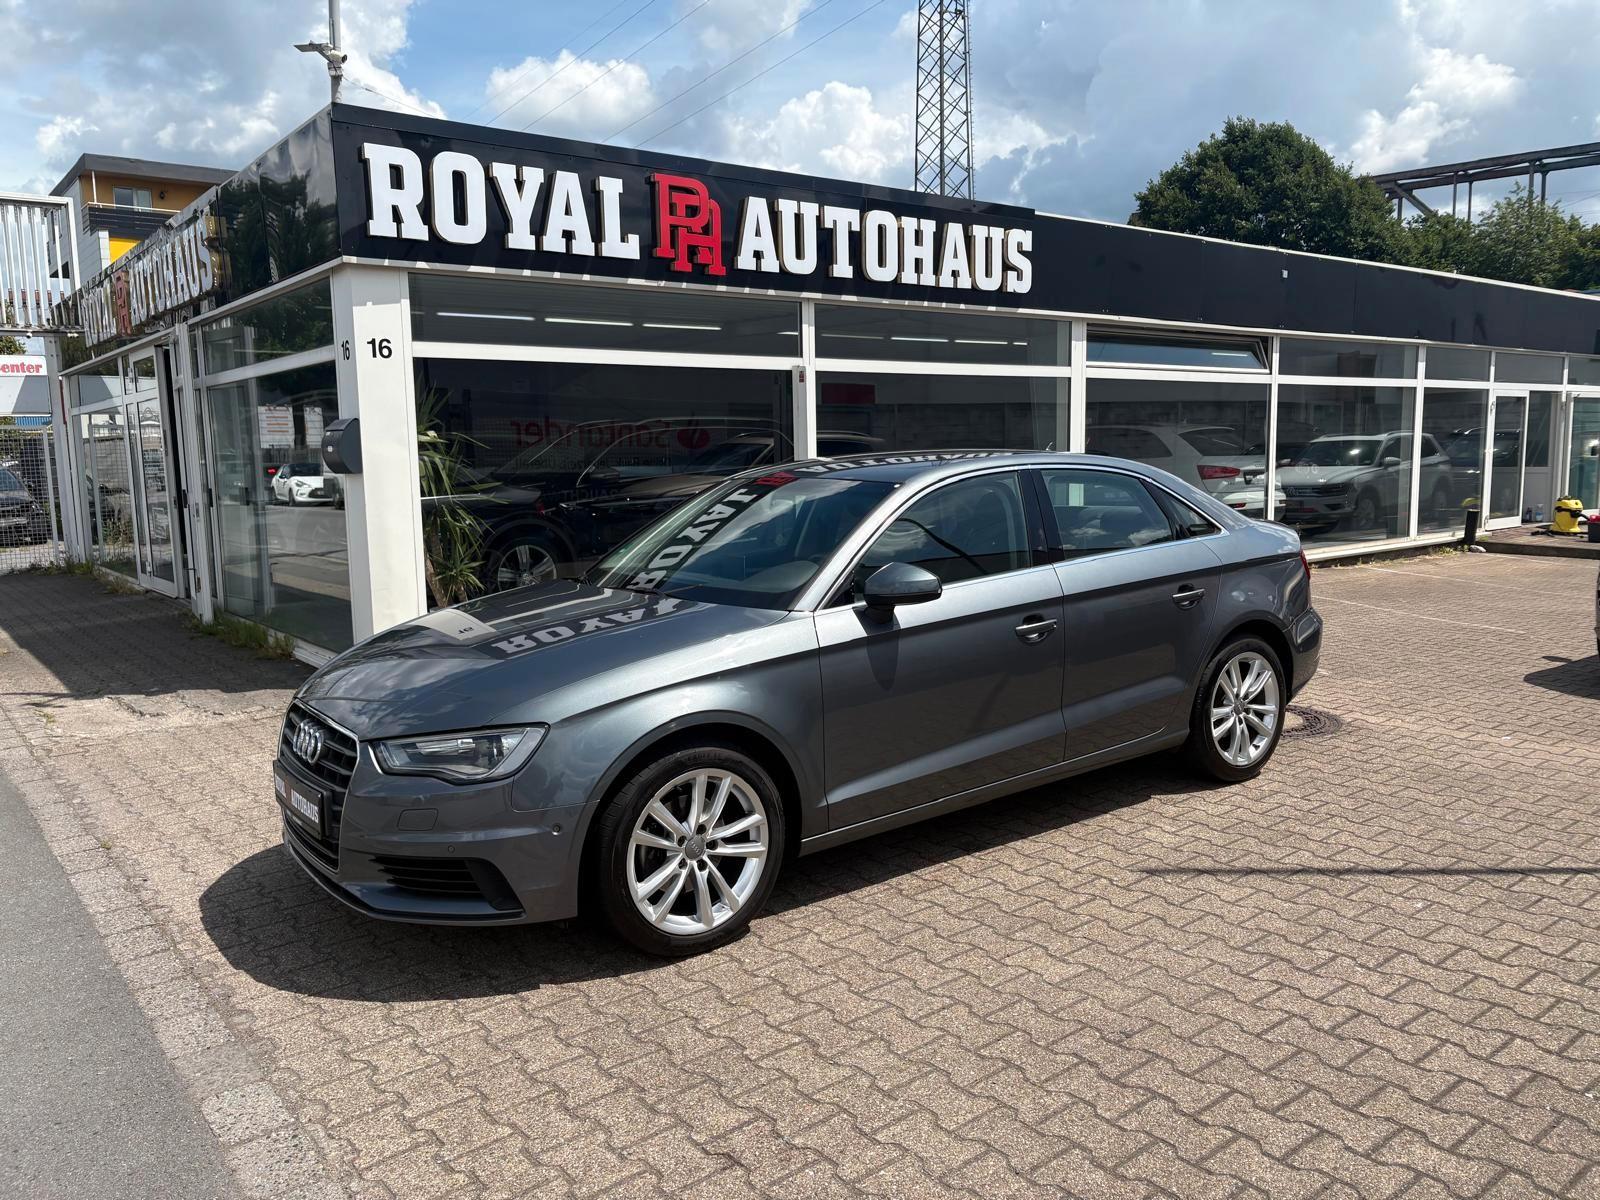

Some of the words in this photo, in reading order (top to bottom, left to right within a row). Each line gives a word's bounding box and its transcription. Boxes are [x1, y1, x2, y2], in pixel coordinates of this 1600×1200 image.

[360, 142, 640, 260] ROYAL
[734, 196, 1033, 294] AUTOHAUS
[129, 208, 214, 327] AUTOHAUS
[341, 340, 350, 360] 16
[367, 338, 392, 358] 16
[0, 362, 42, 373] enter
